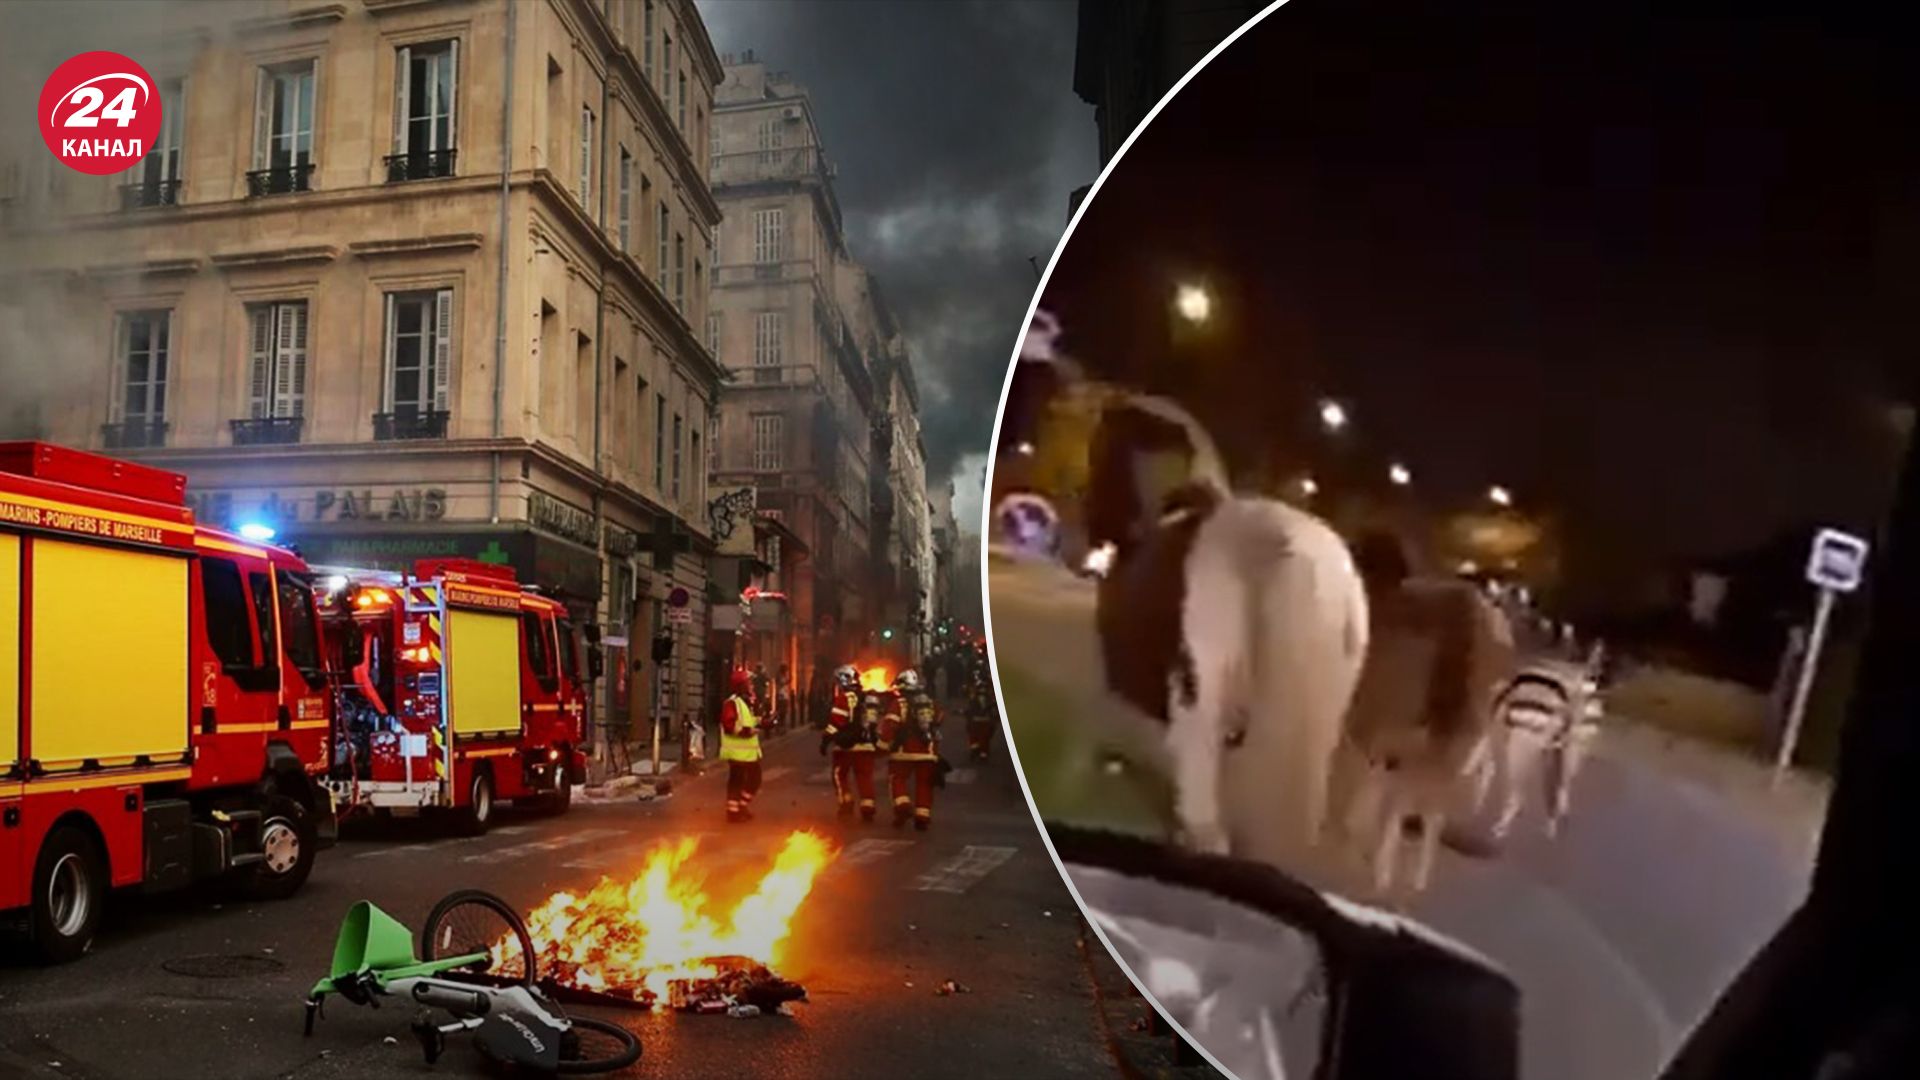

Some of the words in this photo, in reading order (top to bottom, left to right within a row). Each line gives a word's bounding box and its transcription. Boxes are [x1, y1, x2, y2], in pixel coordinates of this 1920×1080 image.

[314, 488, 446, 520] PALAIS
[0, 503, 40, 525] MARINS
[99, 520, 112, 535] DE
[113, 522, 163, 543] MARSEILLE
